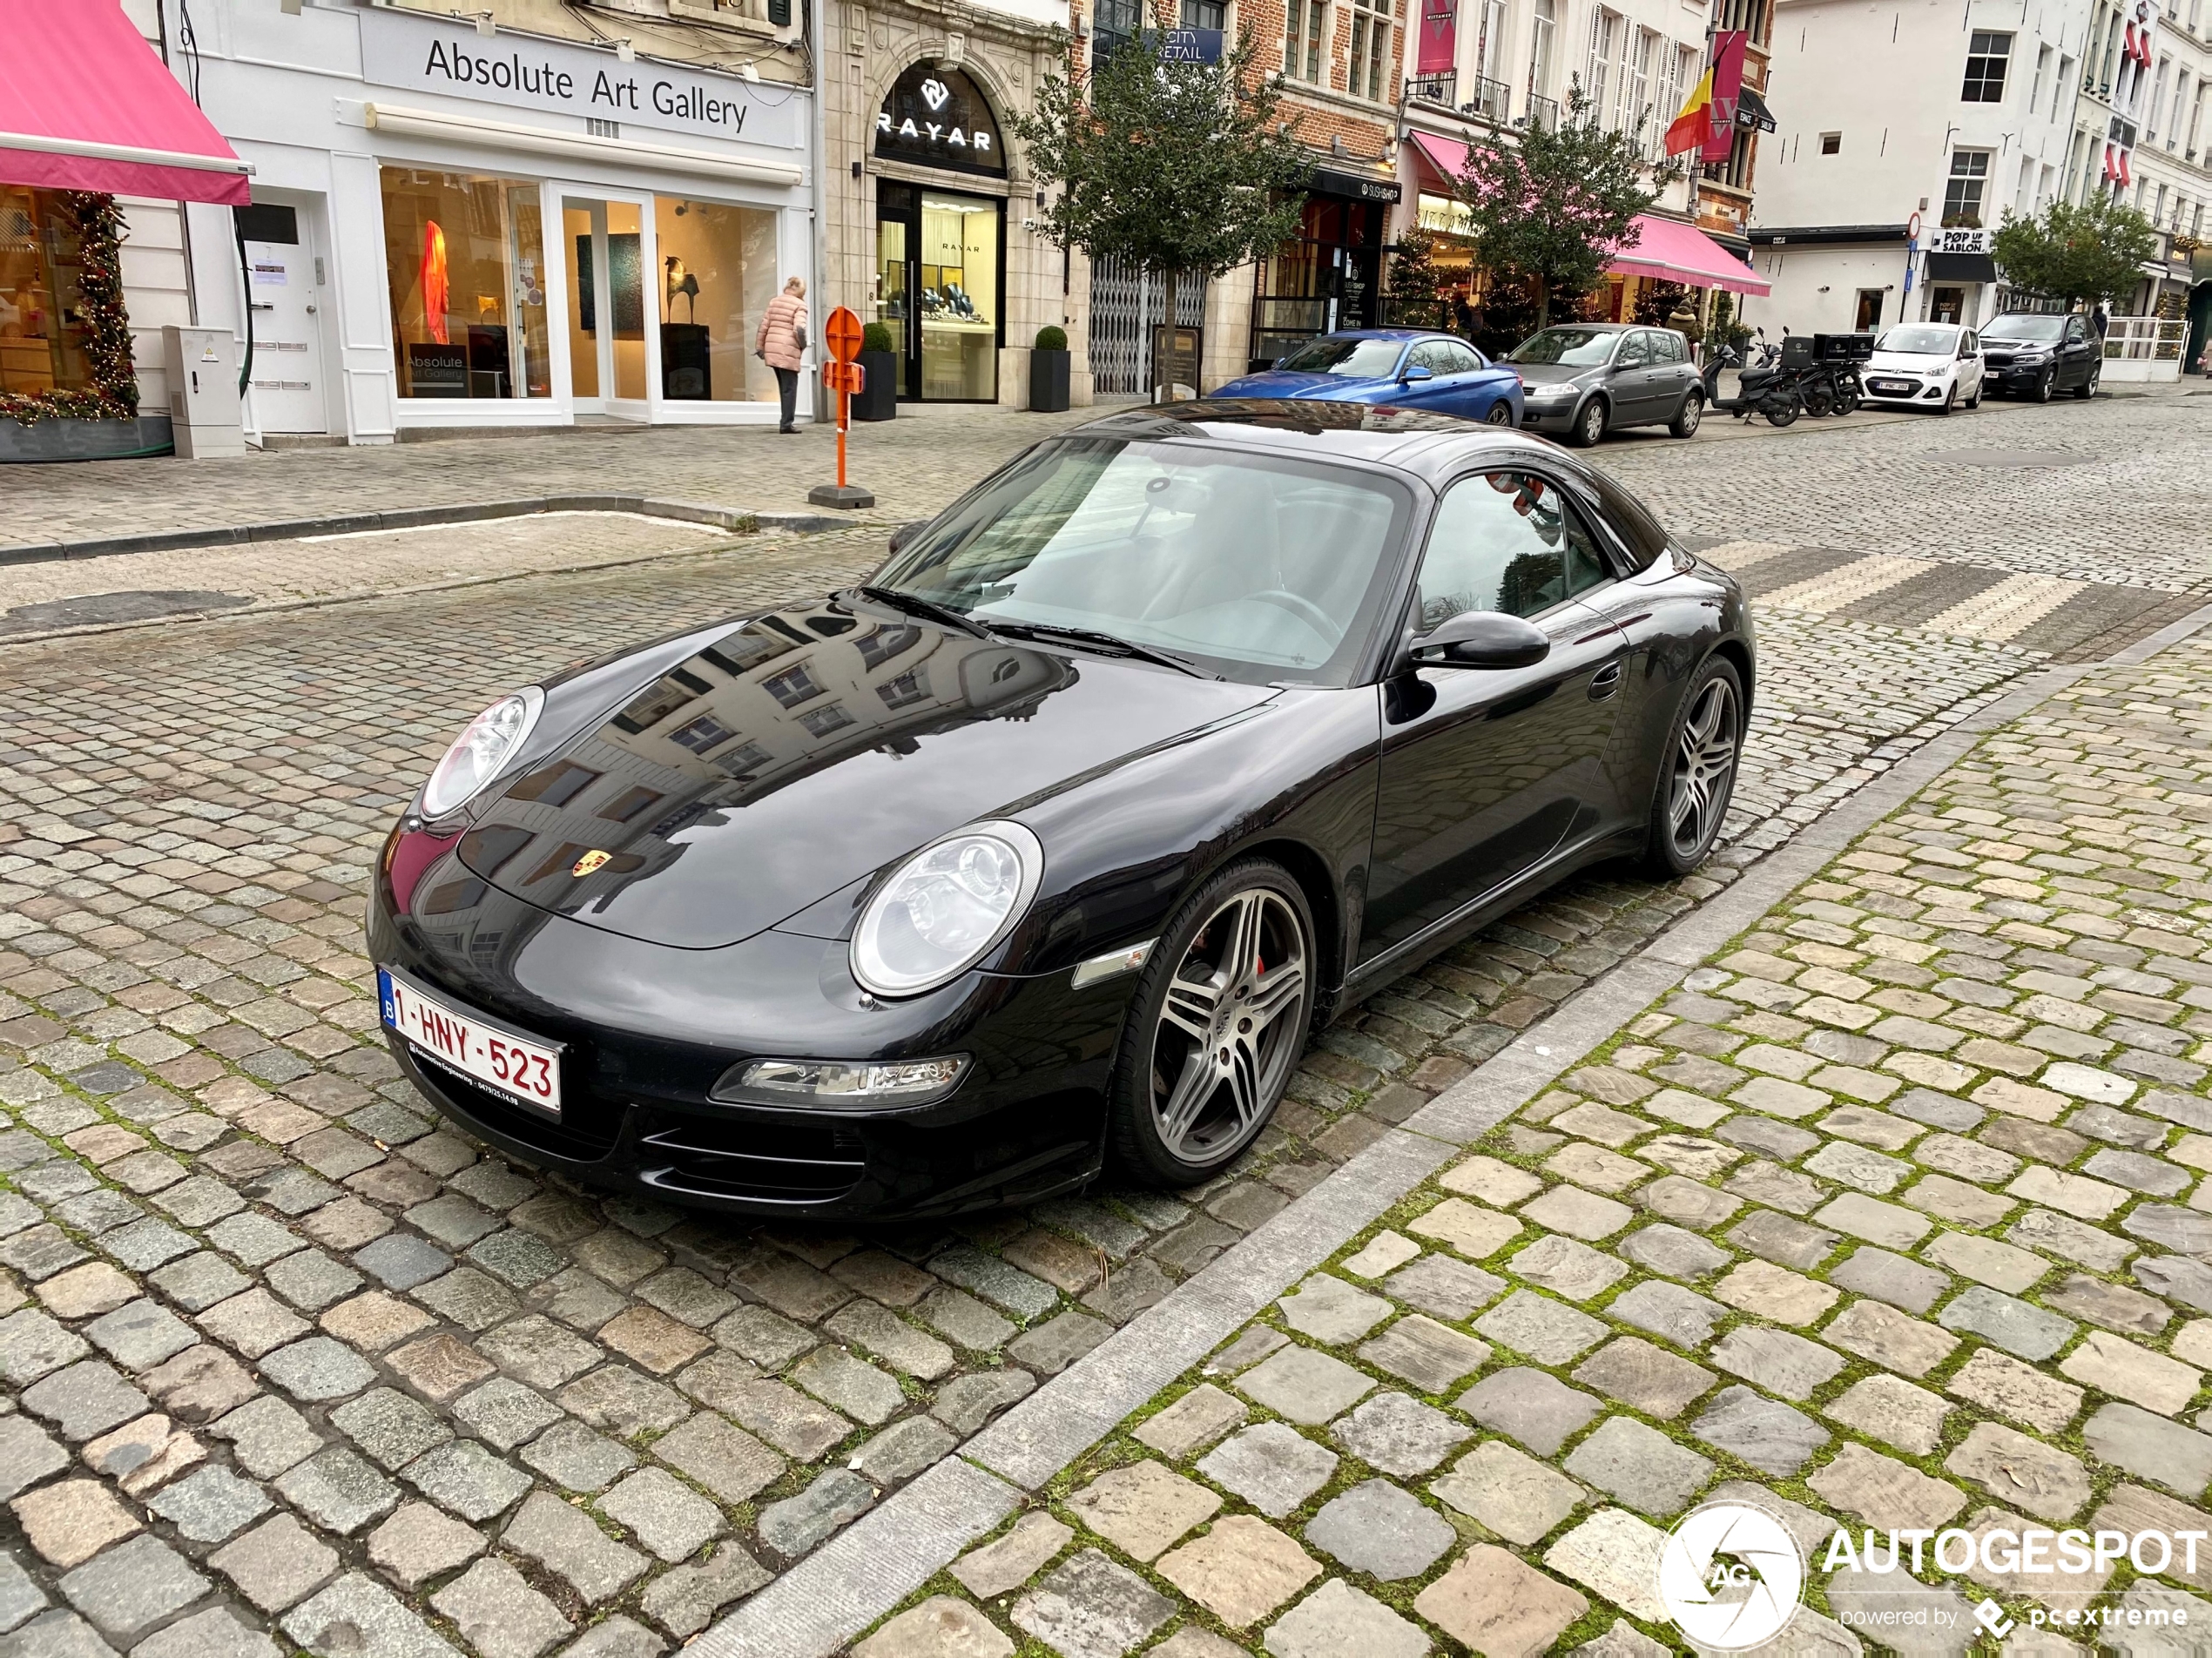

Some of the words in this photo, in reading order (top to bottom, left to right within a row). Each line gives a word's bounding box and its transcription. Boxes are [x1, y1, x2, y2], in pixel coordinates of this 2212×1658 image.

[1167, 31, 1196, 44] CITY
[425, 39, 574, 99] Absolute
[590, 70, 639, 111] Art
[652, 81, 747, 134] Gallery
[875, 112, 990, 151] RAYAR
[942, 243, 980, 253] RAYAR
[869, 292, 873, 300] 8
[407, 356, 462, 367] Absolute
[424, 368, 462, 380] Gallery
[386, 1000, 395, 1020] B
[415, 1048, 442, 1068] Automotive
[442, 1062, 473, 1086] Engineering
